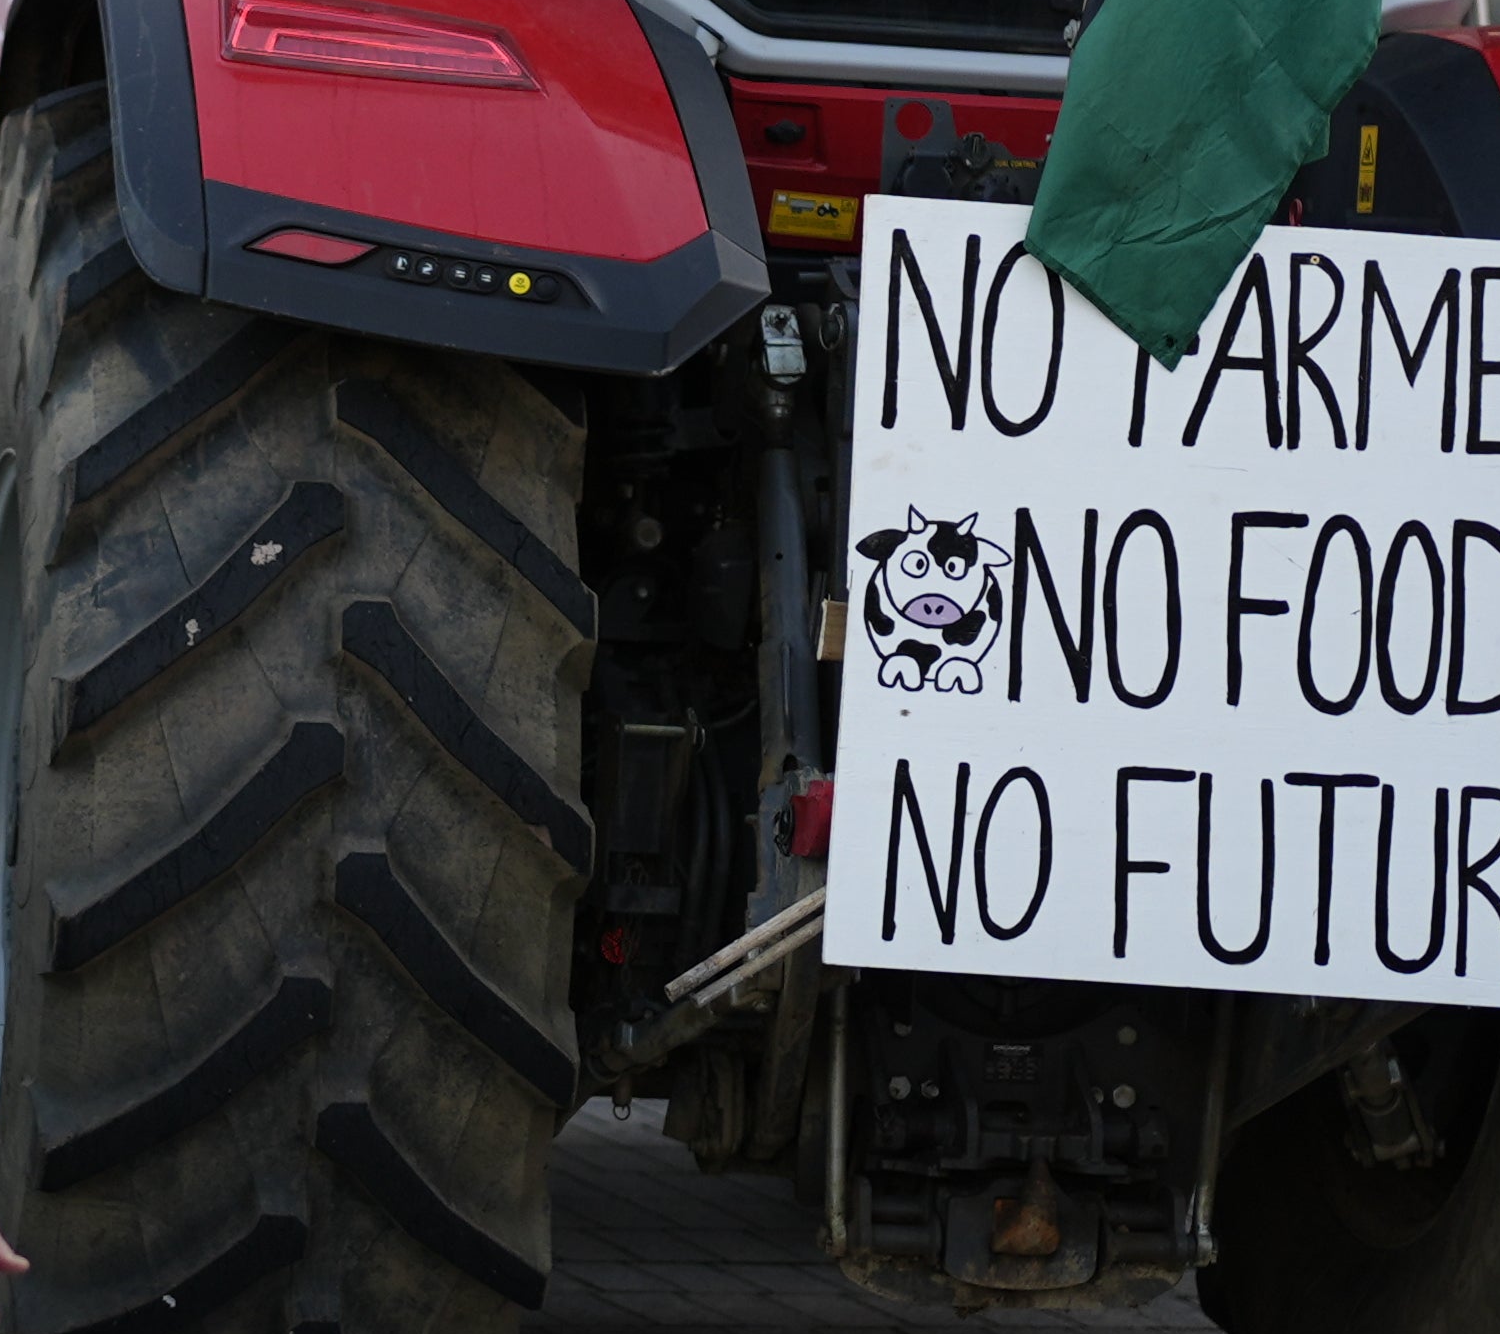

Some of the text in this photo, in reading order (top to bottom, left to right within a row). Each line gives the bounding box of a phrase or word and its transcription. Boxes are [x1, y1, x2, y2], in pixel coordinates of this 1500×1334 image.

[880, 228, 1065, 437] NO
[1008, 508, 1182, 710] NO
[881, 758, 1053, 945] NO
